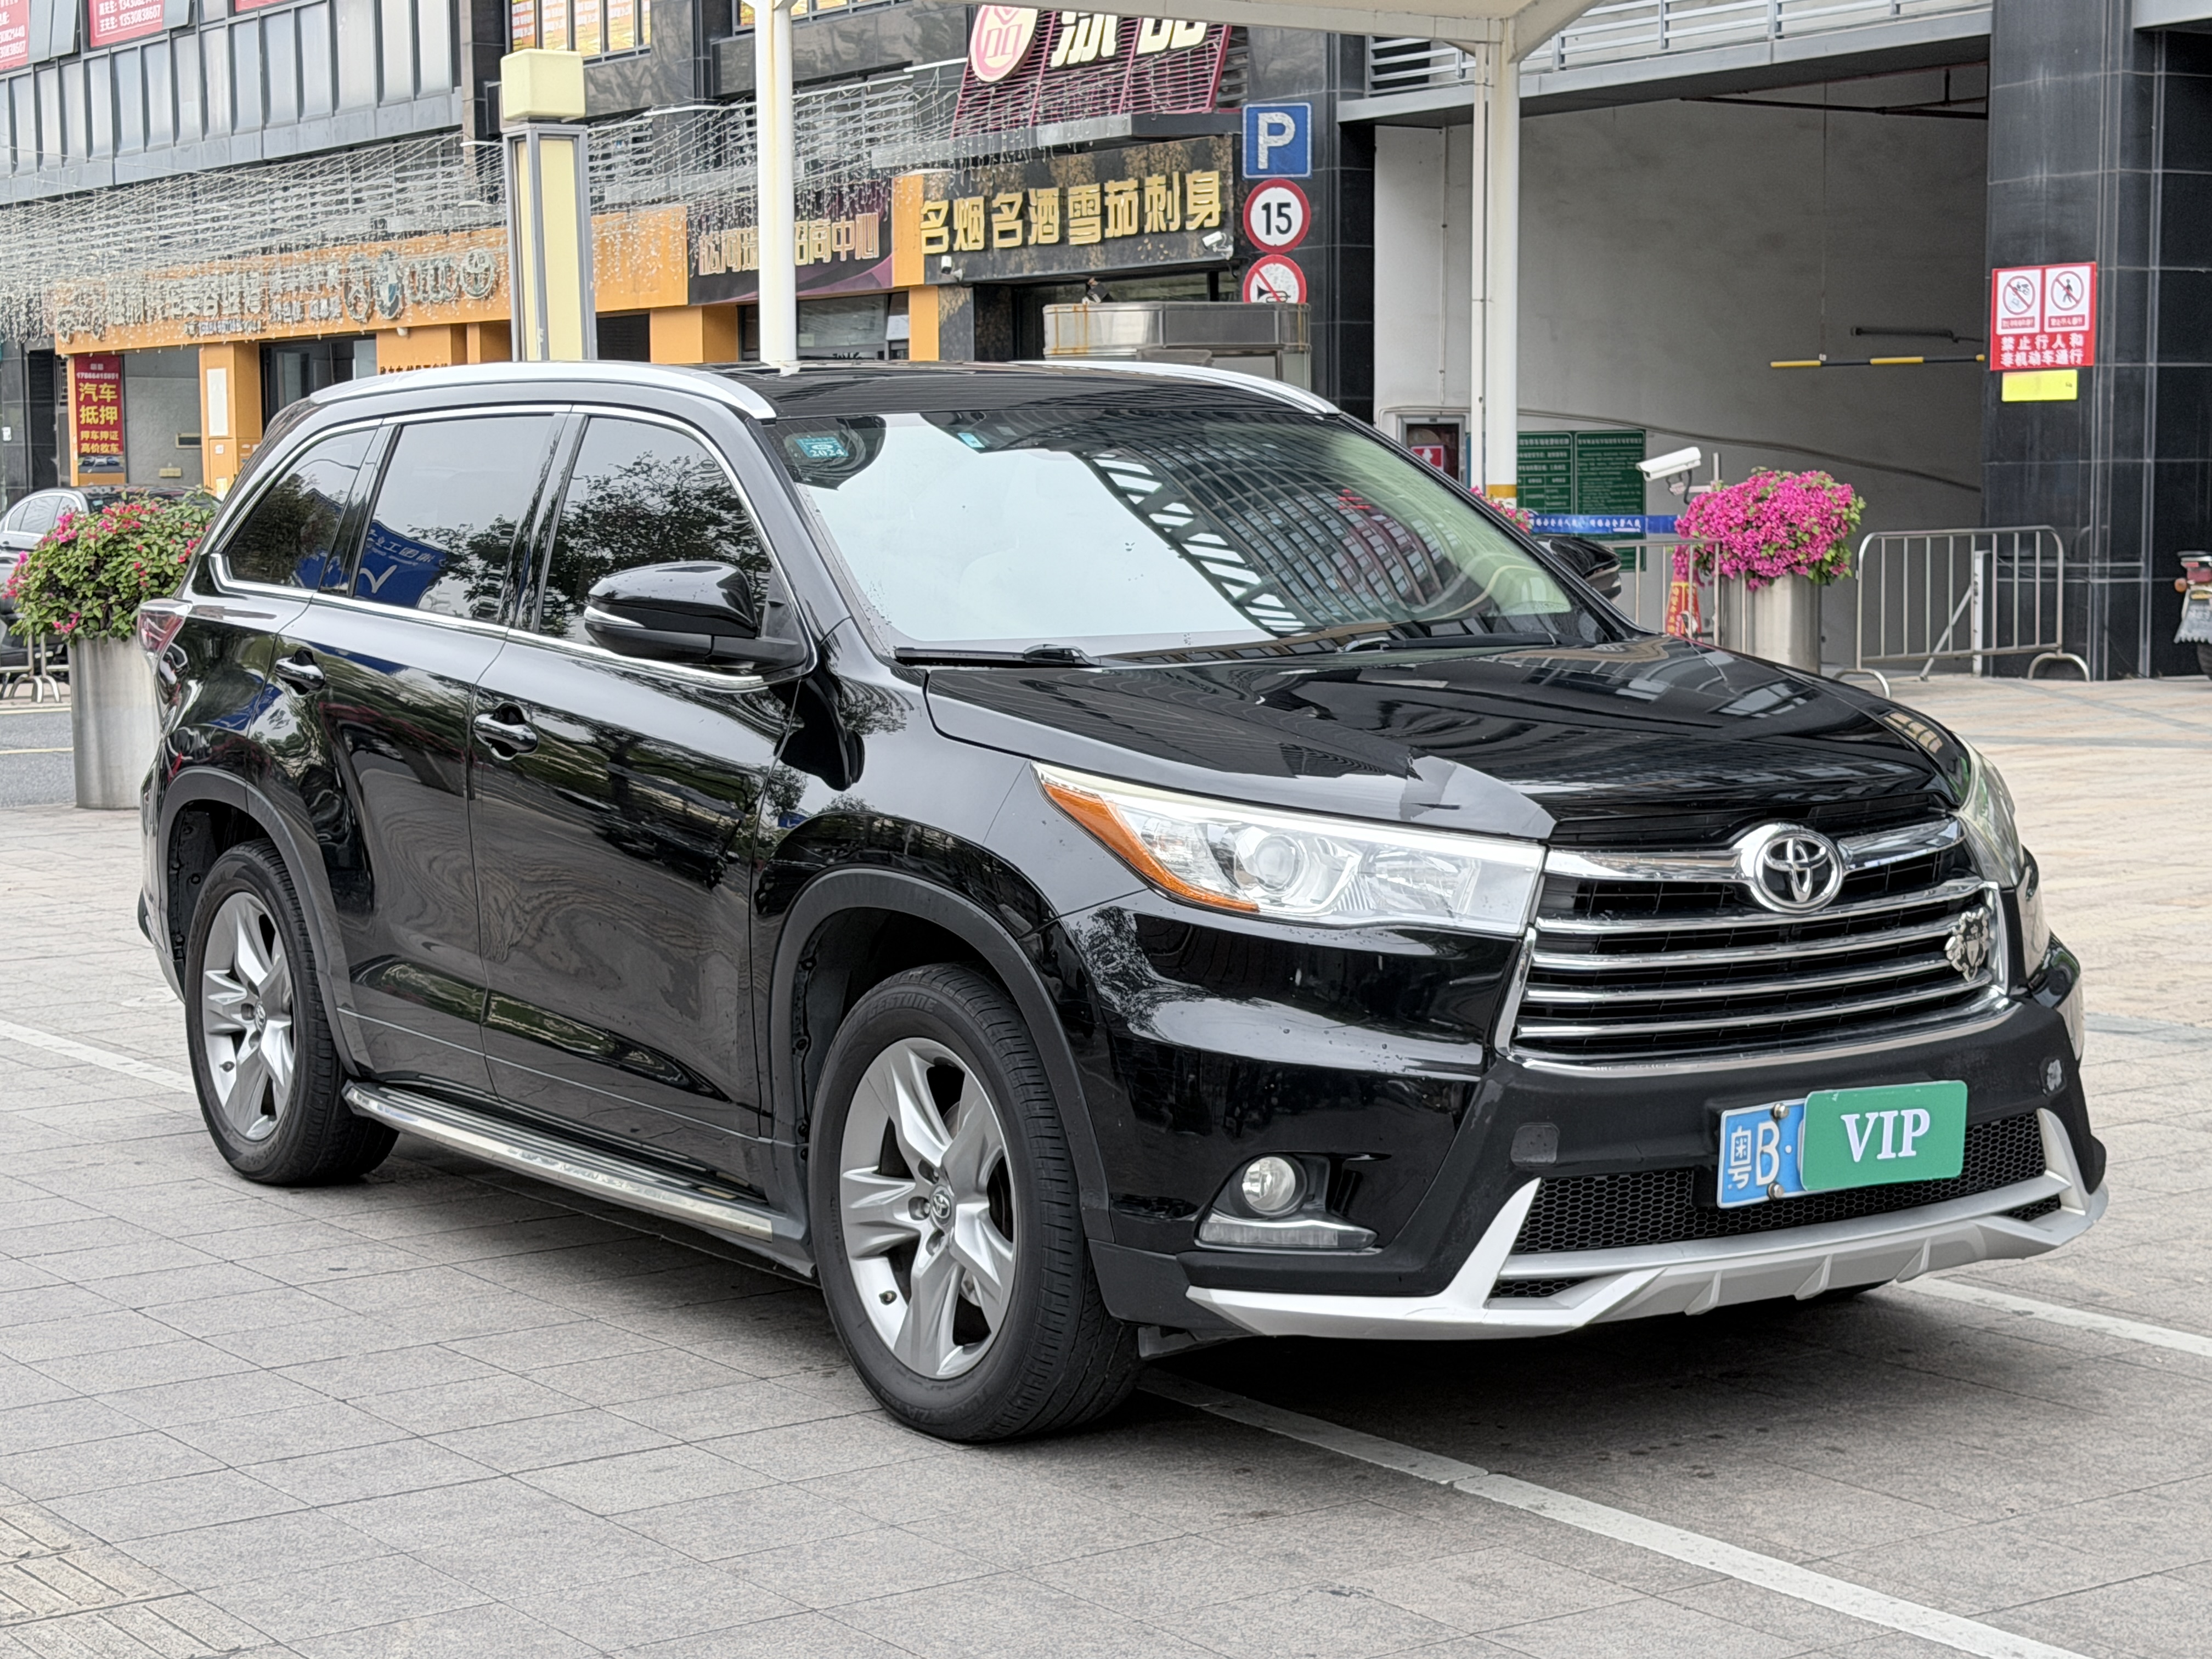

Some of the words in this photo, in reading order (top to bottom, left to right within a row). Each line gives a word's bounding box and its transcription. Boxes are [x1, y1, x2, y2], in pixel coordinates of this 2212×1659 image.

[1257, 112, 1295, 169] P
[919, 169, 1221, 255] 名烟名酒雪茄刺身
[1261, 202, 1292, 235] 15
[2001, 332, 2084, 351] 禁止行人和
[79, 382, 117, 402] 汽车
[80, 405, 118, 425] 抵押
[809, 449, 845, 458] 2024
[1840, 1108, 1931, 1163] VIP
